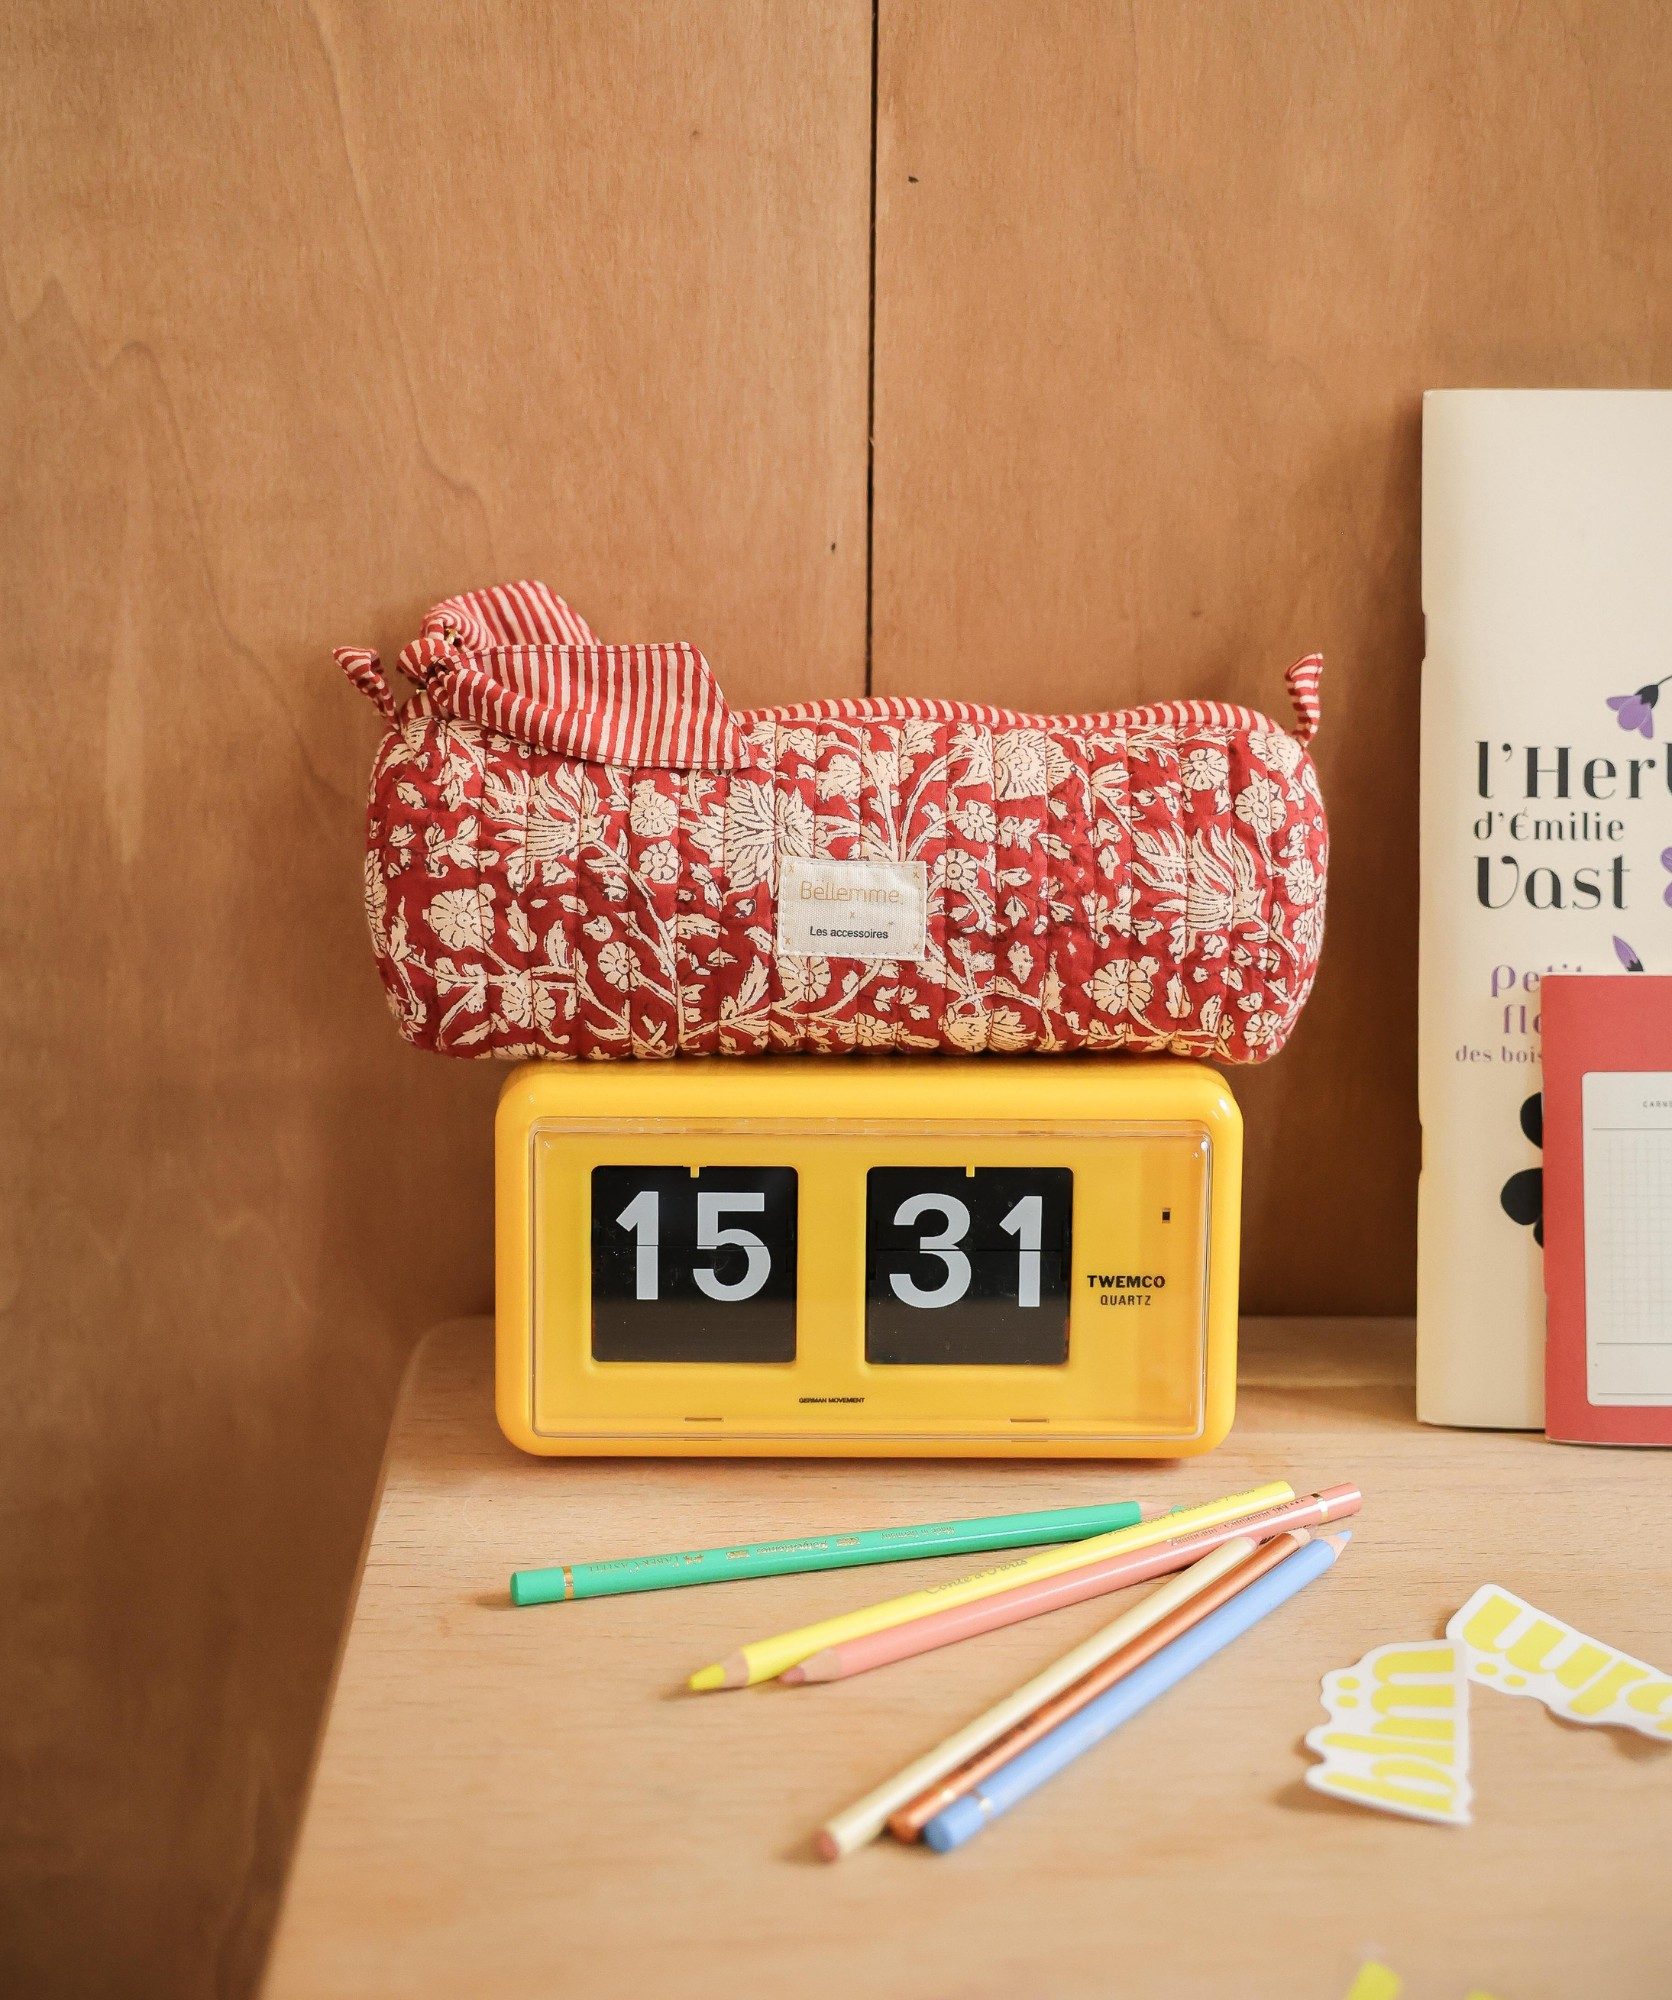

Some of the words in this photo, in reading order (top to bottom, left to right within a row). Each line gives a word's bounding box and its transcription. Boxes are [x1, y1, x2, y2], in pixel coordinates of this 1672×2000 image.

[1473, 806, 1625, 841] d'Émilie
[1474, 854, 1630, 910] Vast
[810, 925, 828, 937] Les
[830, 928, 889, 939] accessoires
[1455, 1044, 1492, 1063] des
[613, 1190, 772, 1302] 15
[888, 1192, 1043, 1309] 31
[1087, 1275, 1165, 1288] TWEMCO
[1100, 1295, 1151, 1306] QUARTZ
